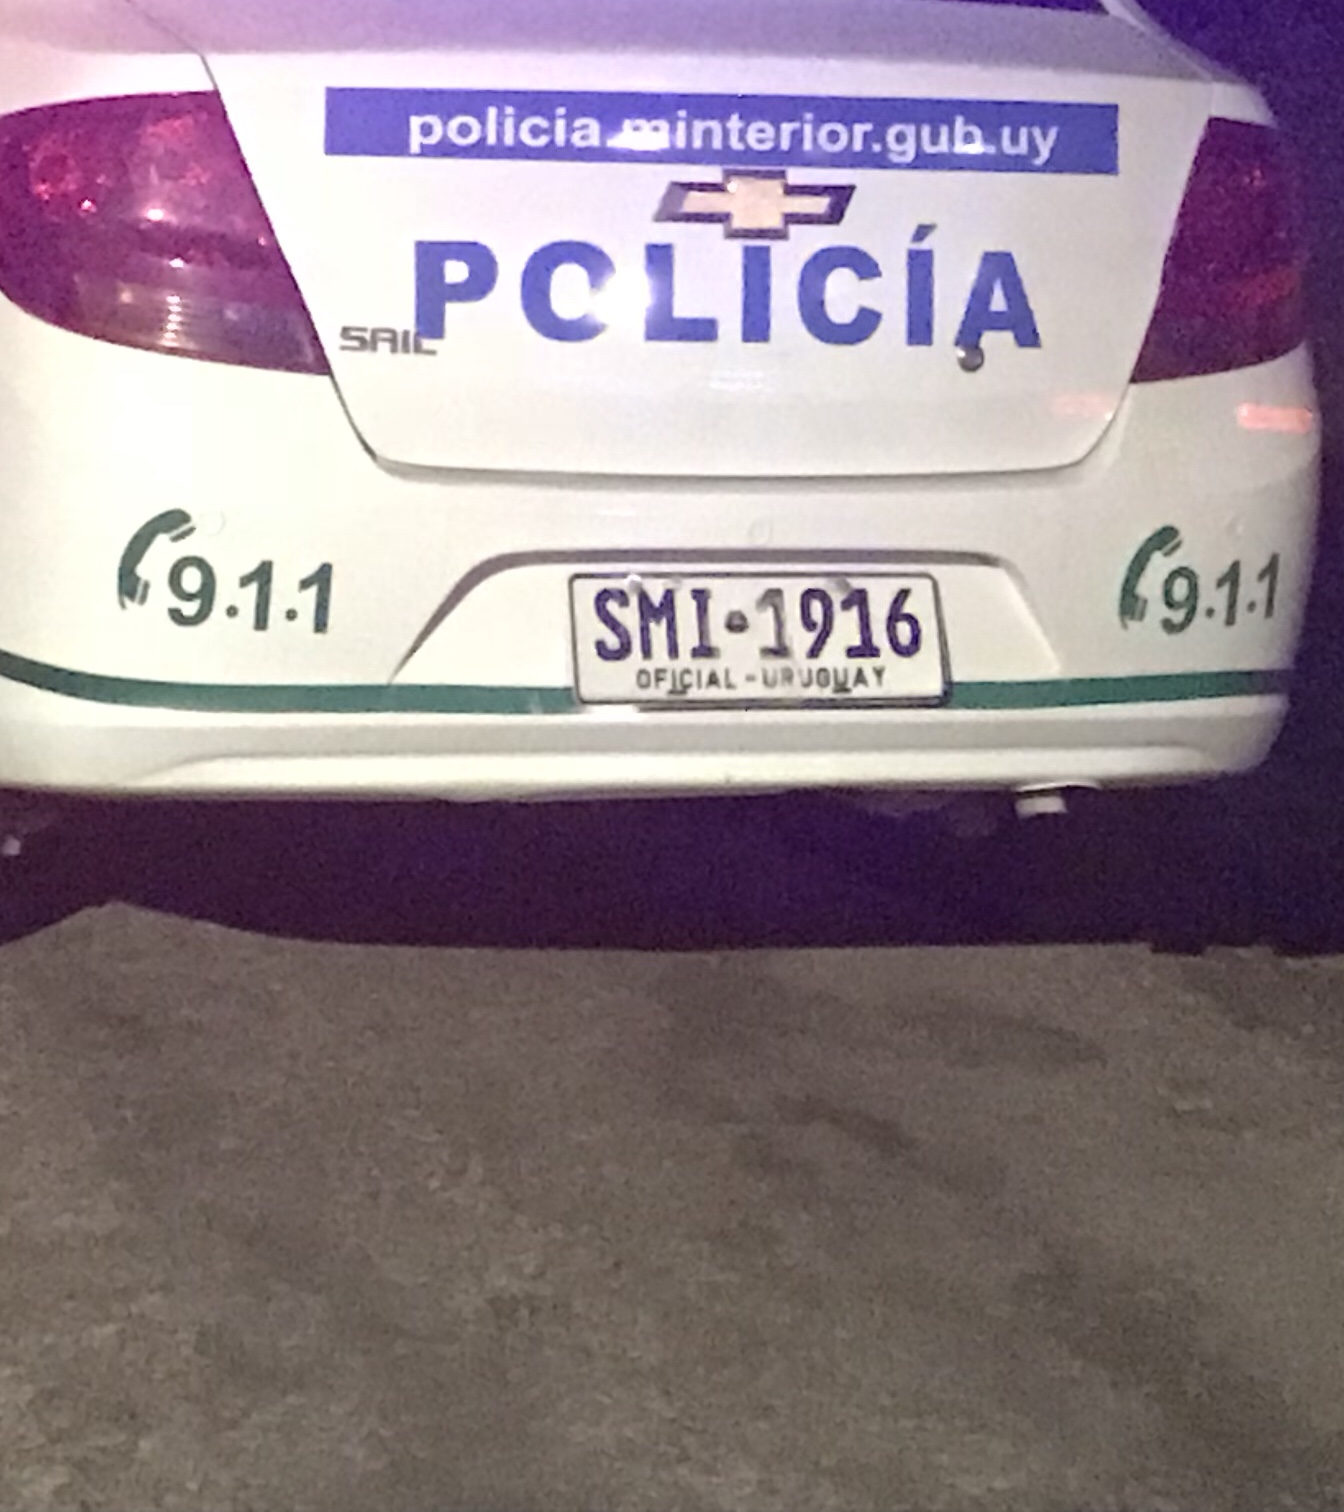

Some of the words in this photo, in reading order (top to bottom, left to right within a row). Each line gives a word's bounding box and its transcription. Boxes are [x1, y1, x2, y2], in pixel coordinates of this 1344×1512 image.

[409, 106, 1059, 165] policia.minterior.gub.uy
[414, 223, 1042, 349] POLICÍA
[339, 325, 438, 356] SAIL
